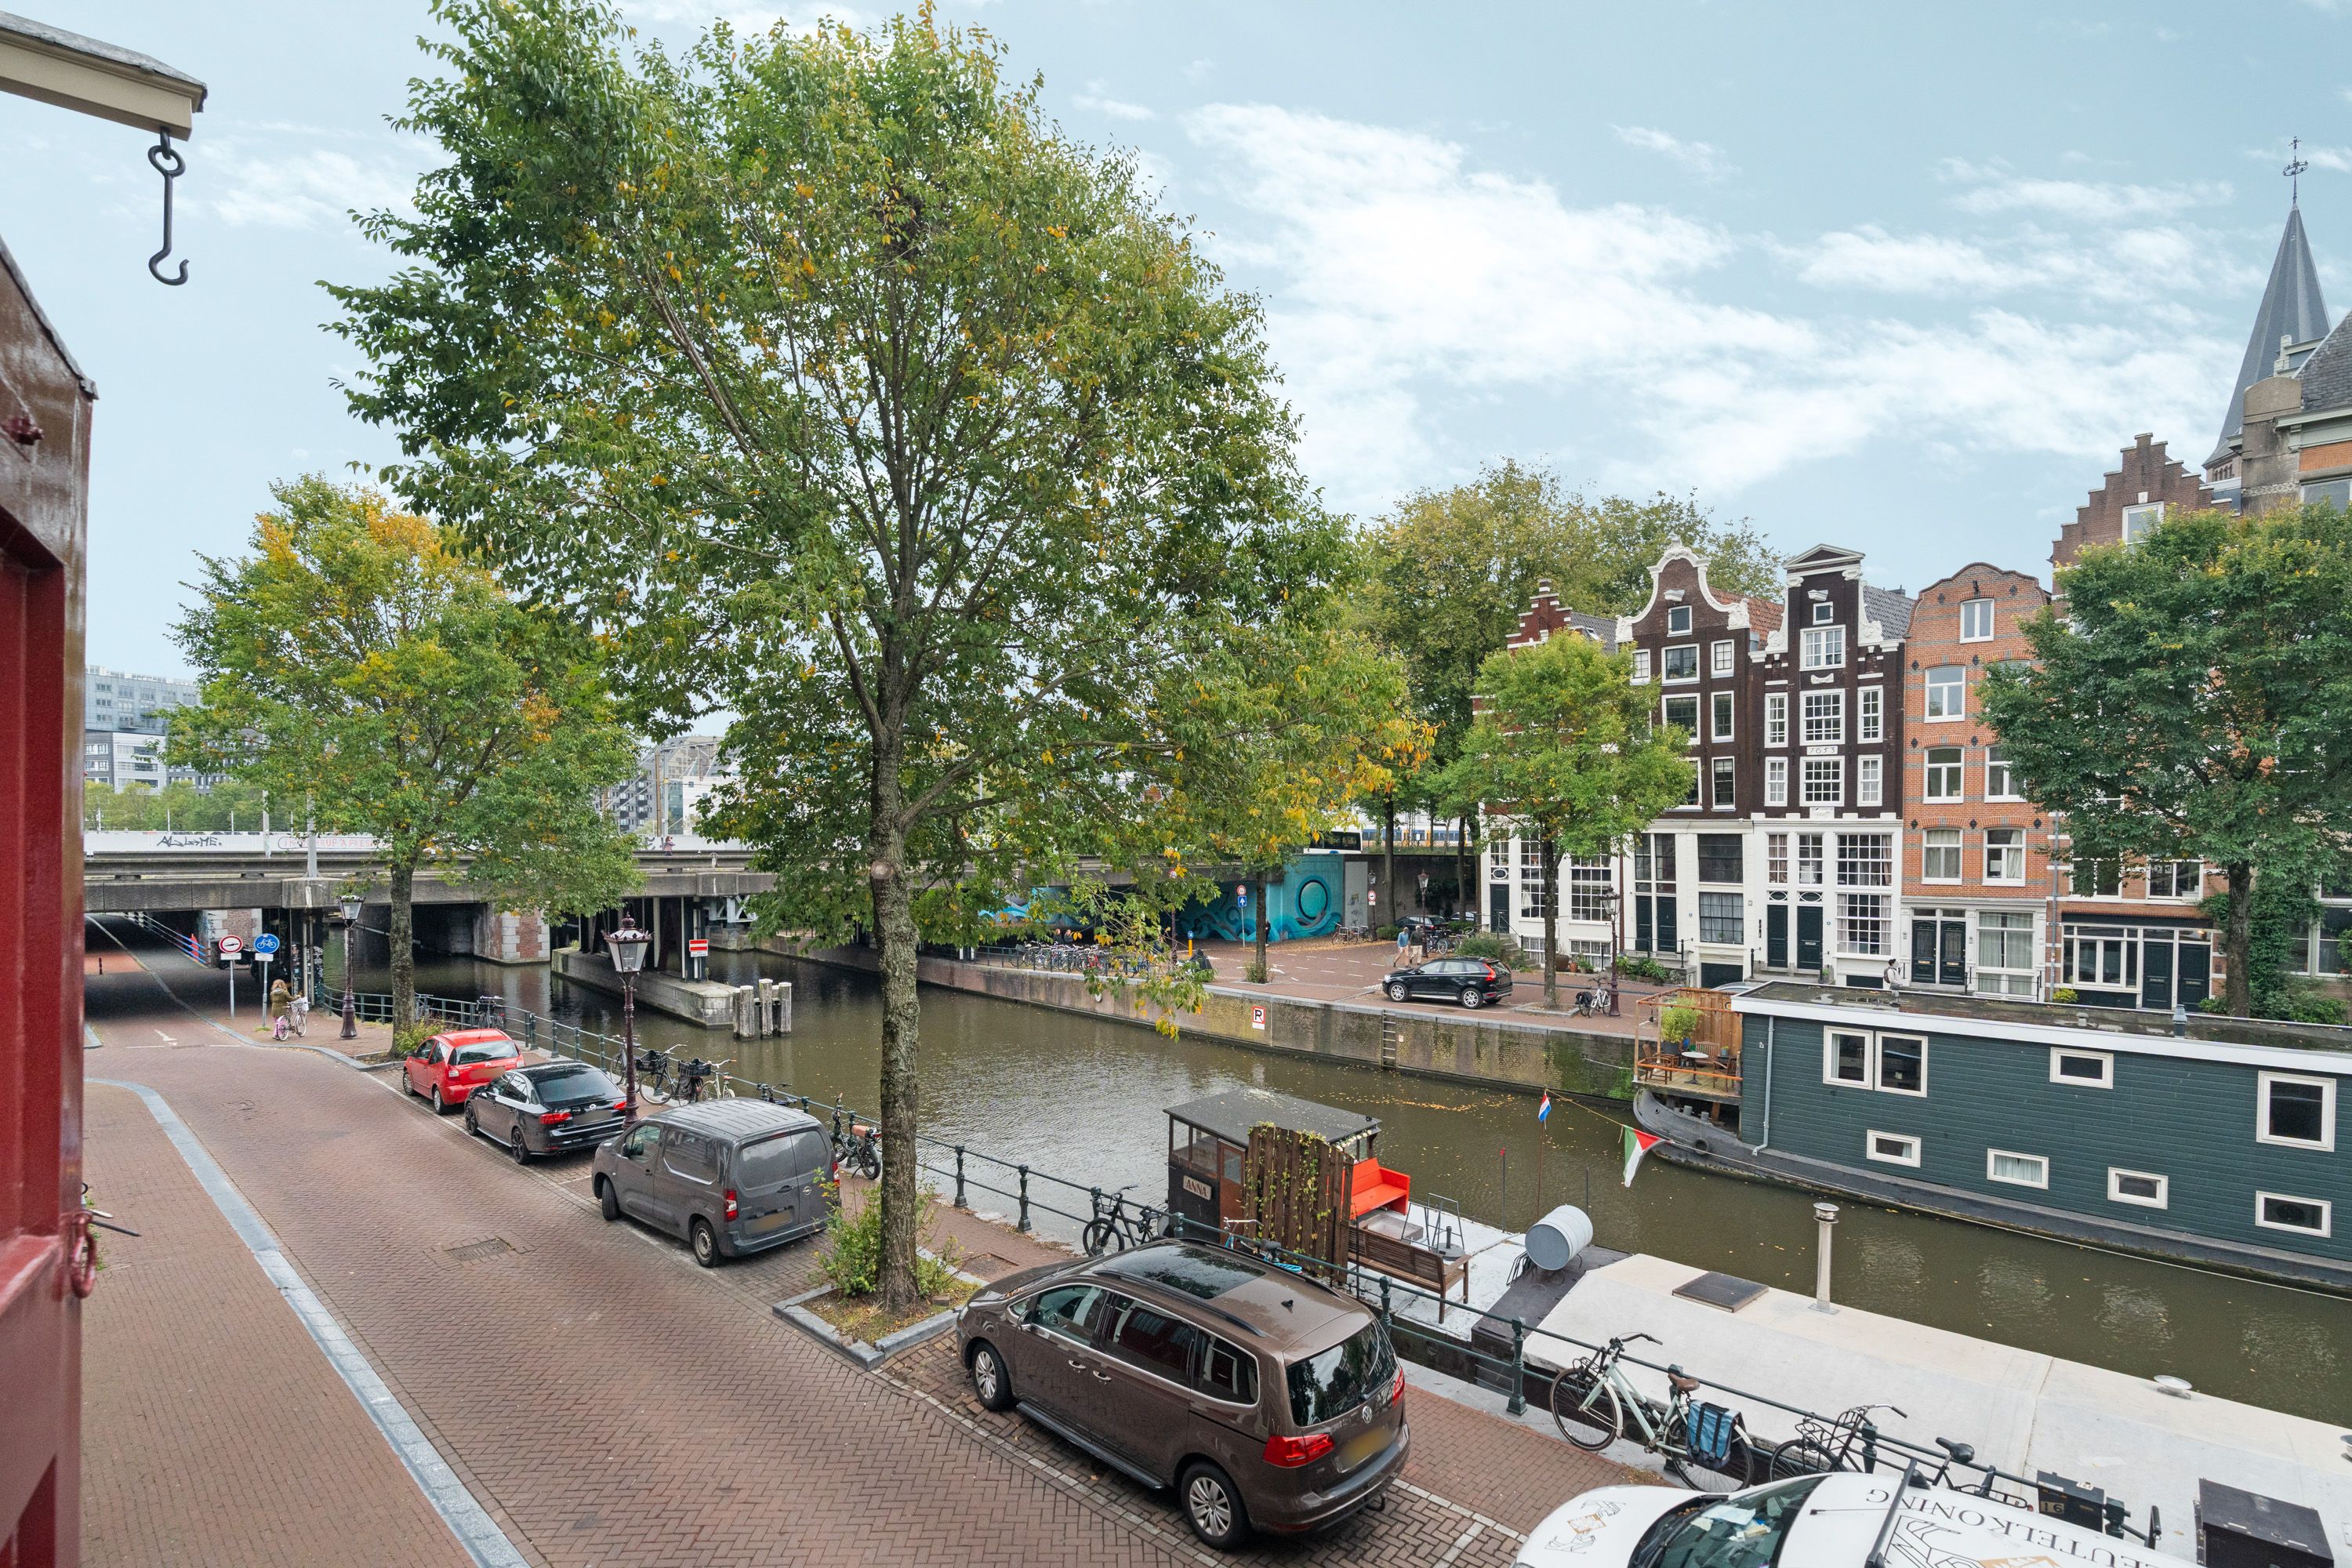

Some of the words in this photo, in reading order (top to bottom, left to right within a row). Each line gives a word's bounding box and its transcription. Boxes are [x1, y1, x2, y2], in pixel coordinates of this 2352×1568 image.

[1185, 1179, 1207, 1197] ANNA
[2043, 1502, 2063, 1514] 16
[1866, 1489, 2158, 1568] EUTELKONING
